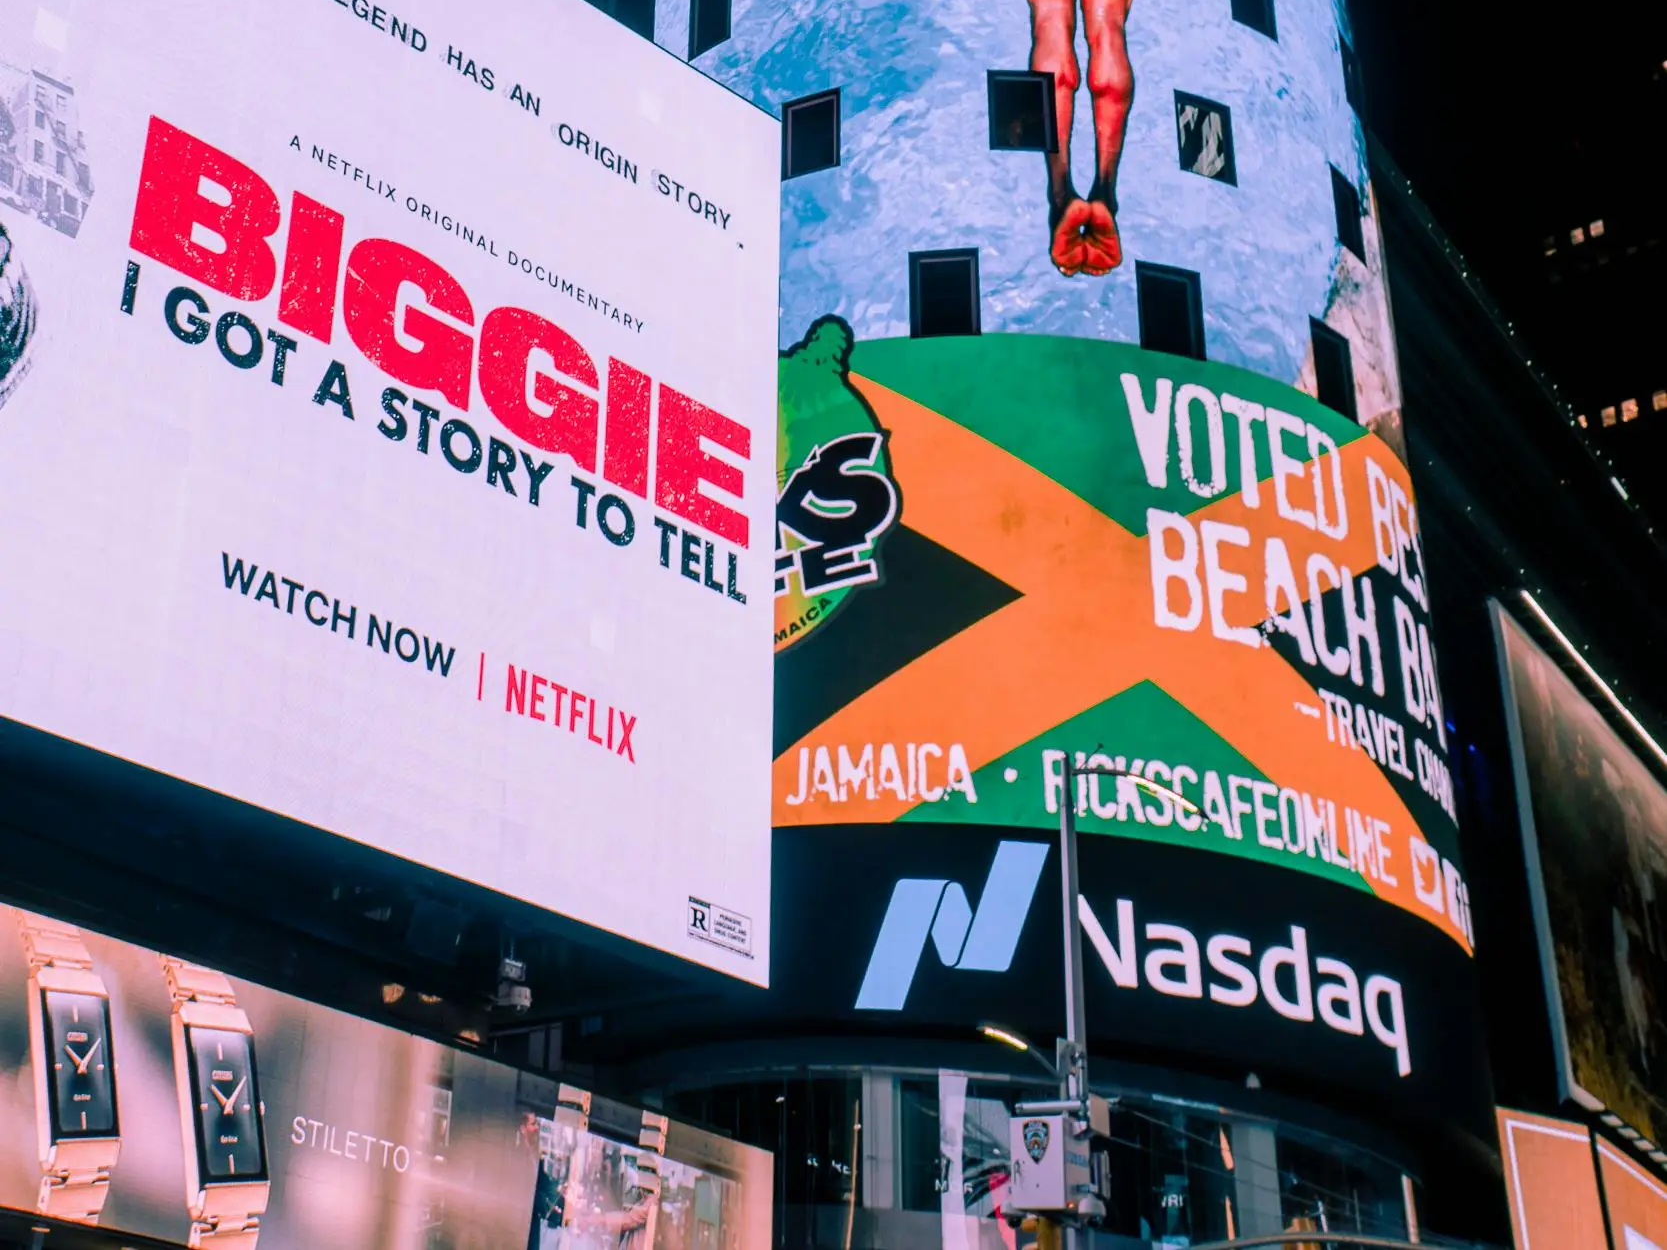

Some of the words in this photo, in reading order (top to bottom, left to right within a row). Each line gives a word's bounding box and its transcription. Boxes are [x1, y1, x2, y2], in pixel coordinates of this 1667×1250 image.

[447, 45, 494, 91] HAS
[510, 84, 540, 116] AN
[559, 124, 637, 184] ORIGIN
[290, 135, 301, 151] A
[312, 145, 396, 202] NETFLIX
[407, 197, 498, 257] ORIGINAL
[508, 251, 645, 333] DOCUMENTARY
[129, 114, 751, 549] BIGGIE
[121, 260, 140, 315] I
[164, 287, 297, 386] GOT
[312, 360, 354, 420] A
[377, 388, 554, 506] STORY
[571, 476, 635, 547] TO
[655, 516, 746, 605] TELL
[1120, 372, 1348, 541] VOTED
[221, 552, 356, 639] WATCH
[367, 614, 456, 677] NOW
[1146, 507, 1383, 695] BEACH
[506, 663, 636, 763] NETFLIX
[786, 743, 976, 804] JAMAICA
[691, 907, 708, 932] R
[1078, 892, 1411, 1077] Nasdaq
[291, 1116, 410, 1173] STILETTO
